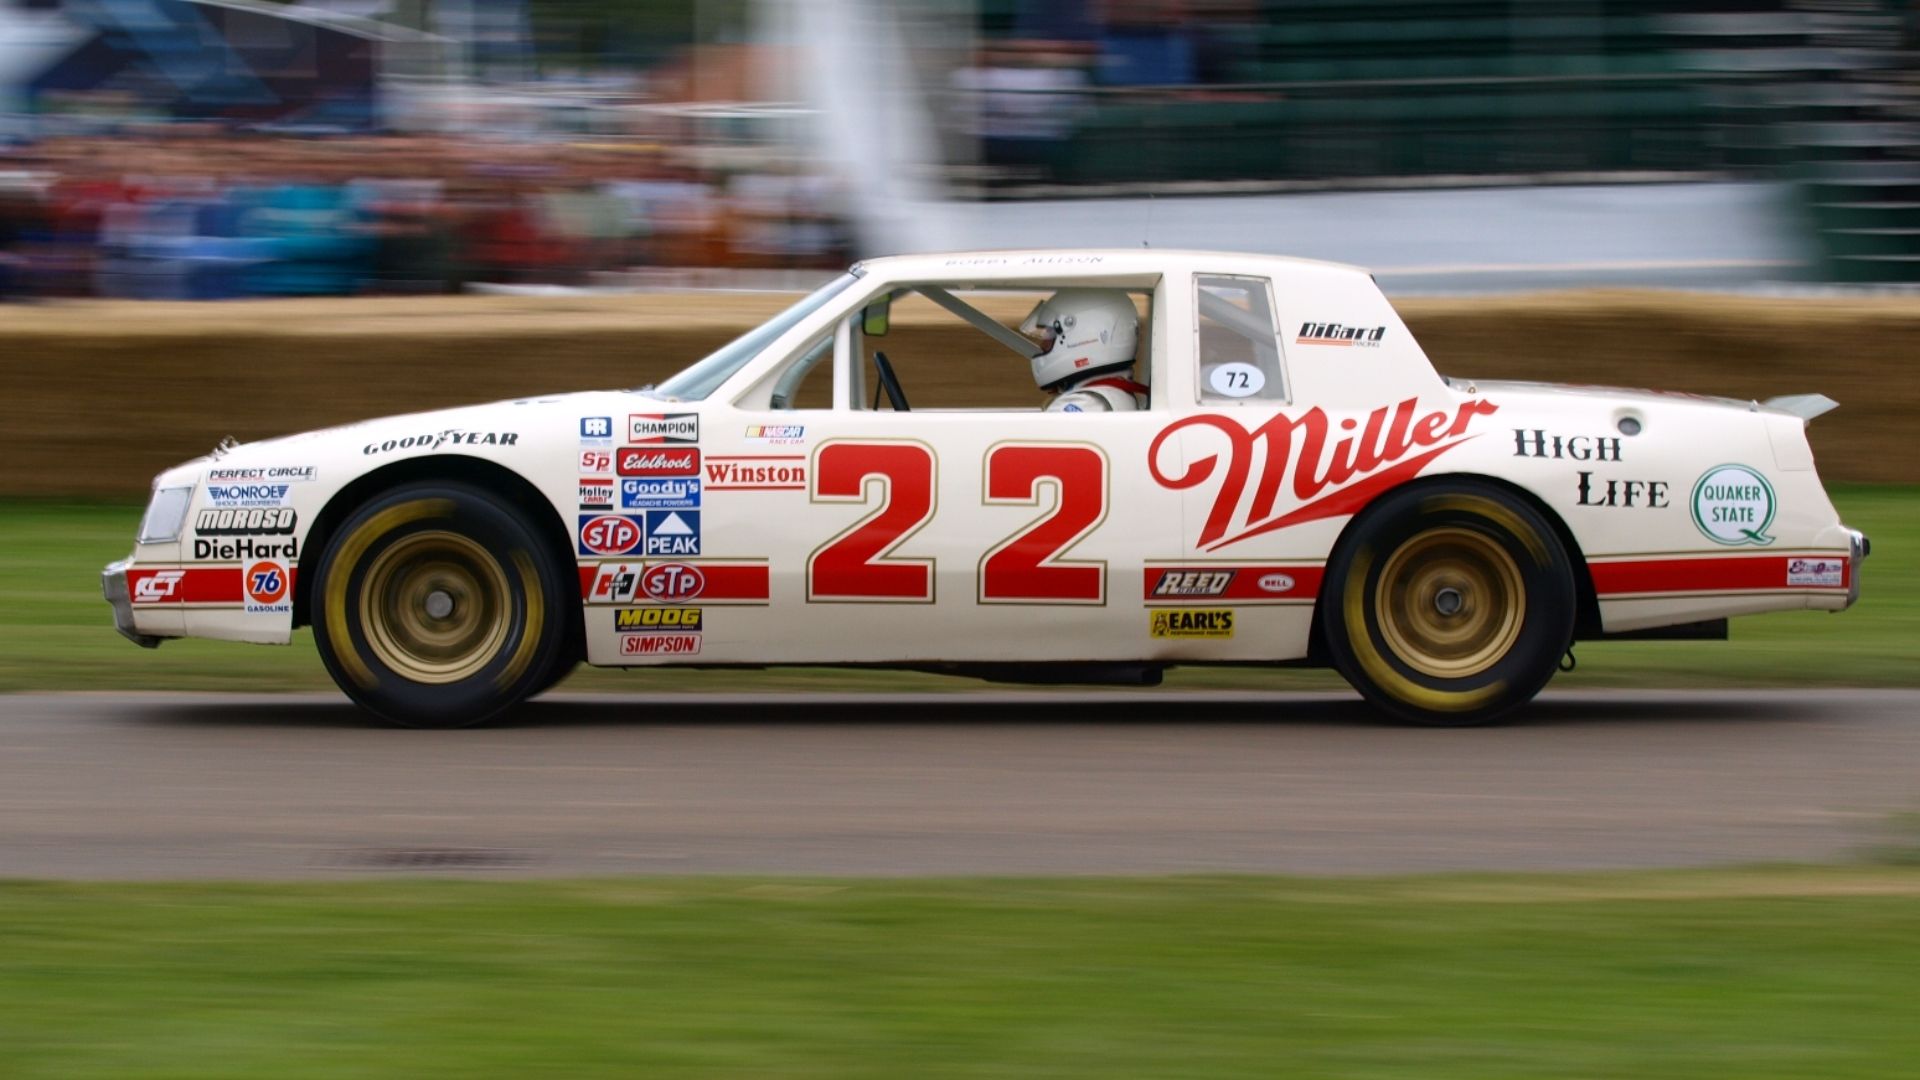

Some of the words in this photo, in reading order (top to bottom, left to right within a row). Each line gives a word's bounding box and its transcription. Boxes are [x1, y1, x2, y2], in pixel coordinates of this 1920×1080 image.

[1298, 322, 1386, 341] DiGard
[1226, 372, 1249, 388] 72
[634, 422, 696, 433] CHAMPION
[363, 431, 518, 455] GOODYEAR
[1512, 429, 1623, 461] HIGH
[623, 453, 692, 470] Edelbrock
[210, 469, 265, 479] PERFECT
[268, 467, 313, 477] CIRCLE
[705, 463, 805, 483] Winston
[1148, 397, 1498, 549] Miller
[217, 485, 279, 499] MONROE
[579, 486, 613, 497] Holley
[623, 480, 699, 500] Goody's
[1576, 471, 1670, 508] LIFE
[1704, 485, 1761, 501] QUAKER
[629, 499, 661, 507] HEADACHE
[195, 508, 298, 536] MOROSO
[806, 437, 1110, 606] 22
[1712, 506, 1754, 523] STATE
[588, 519, 632, 548] STP
[194, 537, 298, 559] DieHard
[648, 537, 698, 554] PEAK
[251, 570, 282, 595] 76
[649, 567, 696, 595] STP
[1155, 572, 1232, 595] REED
[247, 605, 290, 613] GASOLINE
[618, 608, 700, 626] MOOG
[1169, 611, 1232, 630] EARL'S
[626, 636, 695, 652] SIMPSON
